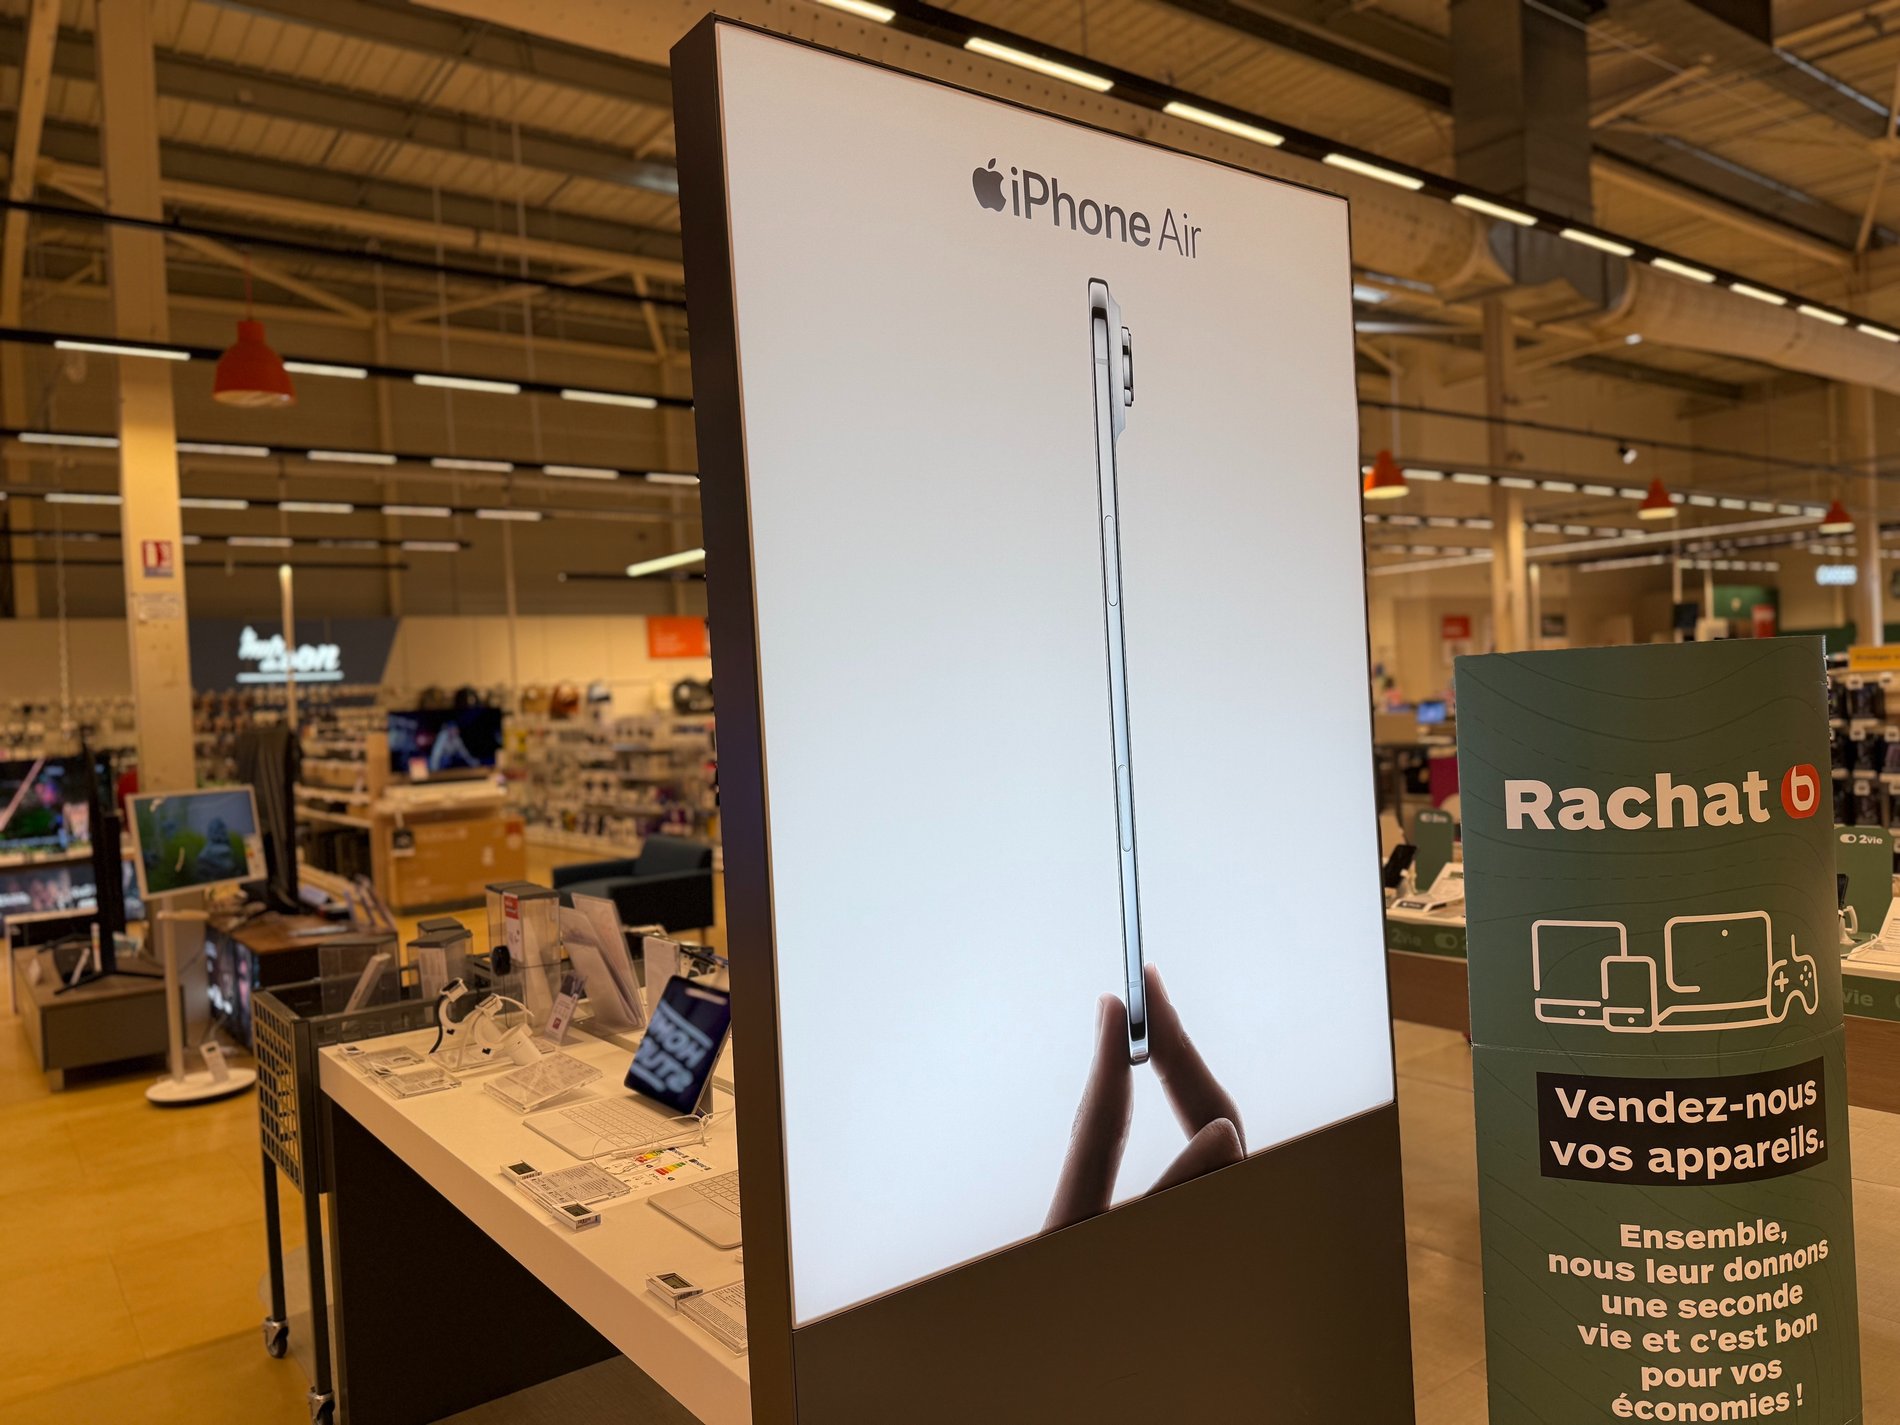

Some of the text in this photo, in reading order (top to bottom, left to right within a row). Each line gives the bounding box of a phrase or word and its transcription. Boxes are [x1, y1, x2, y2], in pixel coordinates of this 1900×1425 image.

[1011, 166, 1202, 259] iPhone Air
[1504, 770, 1771, 831] Rachat
[1858, 834, 1884, 845] 2vie
[1842, 989, 1875, 1007] vie
[1554, 1079, 1818, 1124] Vendez-nous
[1549, 1124, 1825, 1181] vos appareils.
[1620, 1218, 1787, 1250] Ensemble,
[1548, 1236, 1829, 1285] nous leur donnons
[1601, 1282, 1803, 1319] une seconde
[1577, 1311, 1818, 1354] vie et c'est bon
[1641, 1358, 1783, 1392] pour vos
[1611, 1391, 1790, 1422] économies
